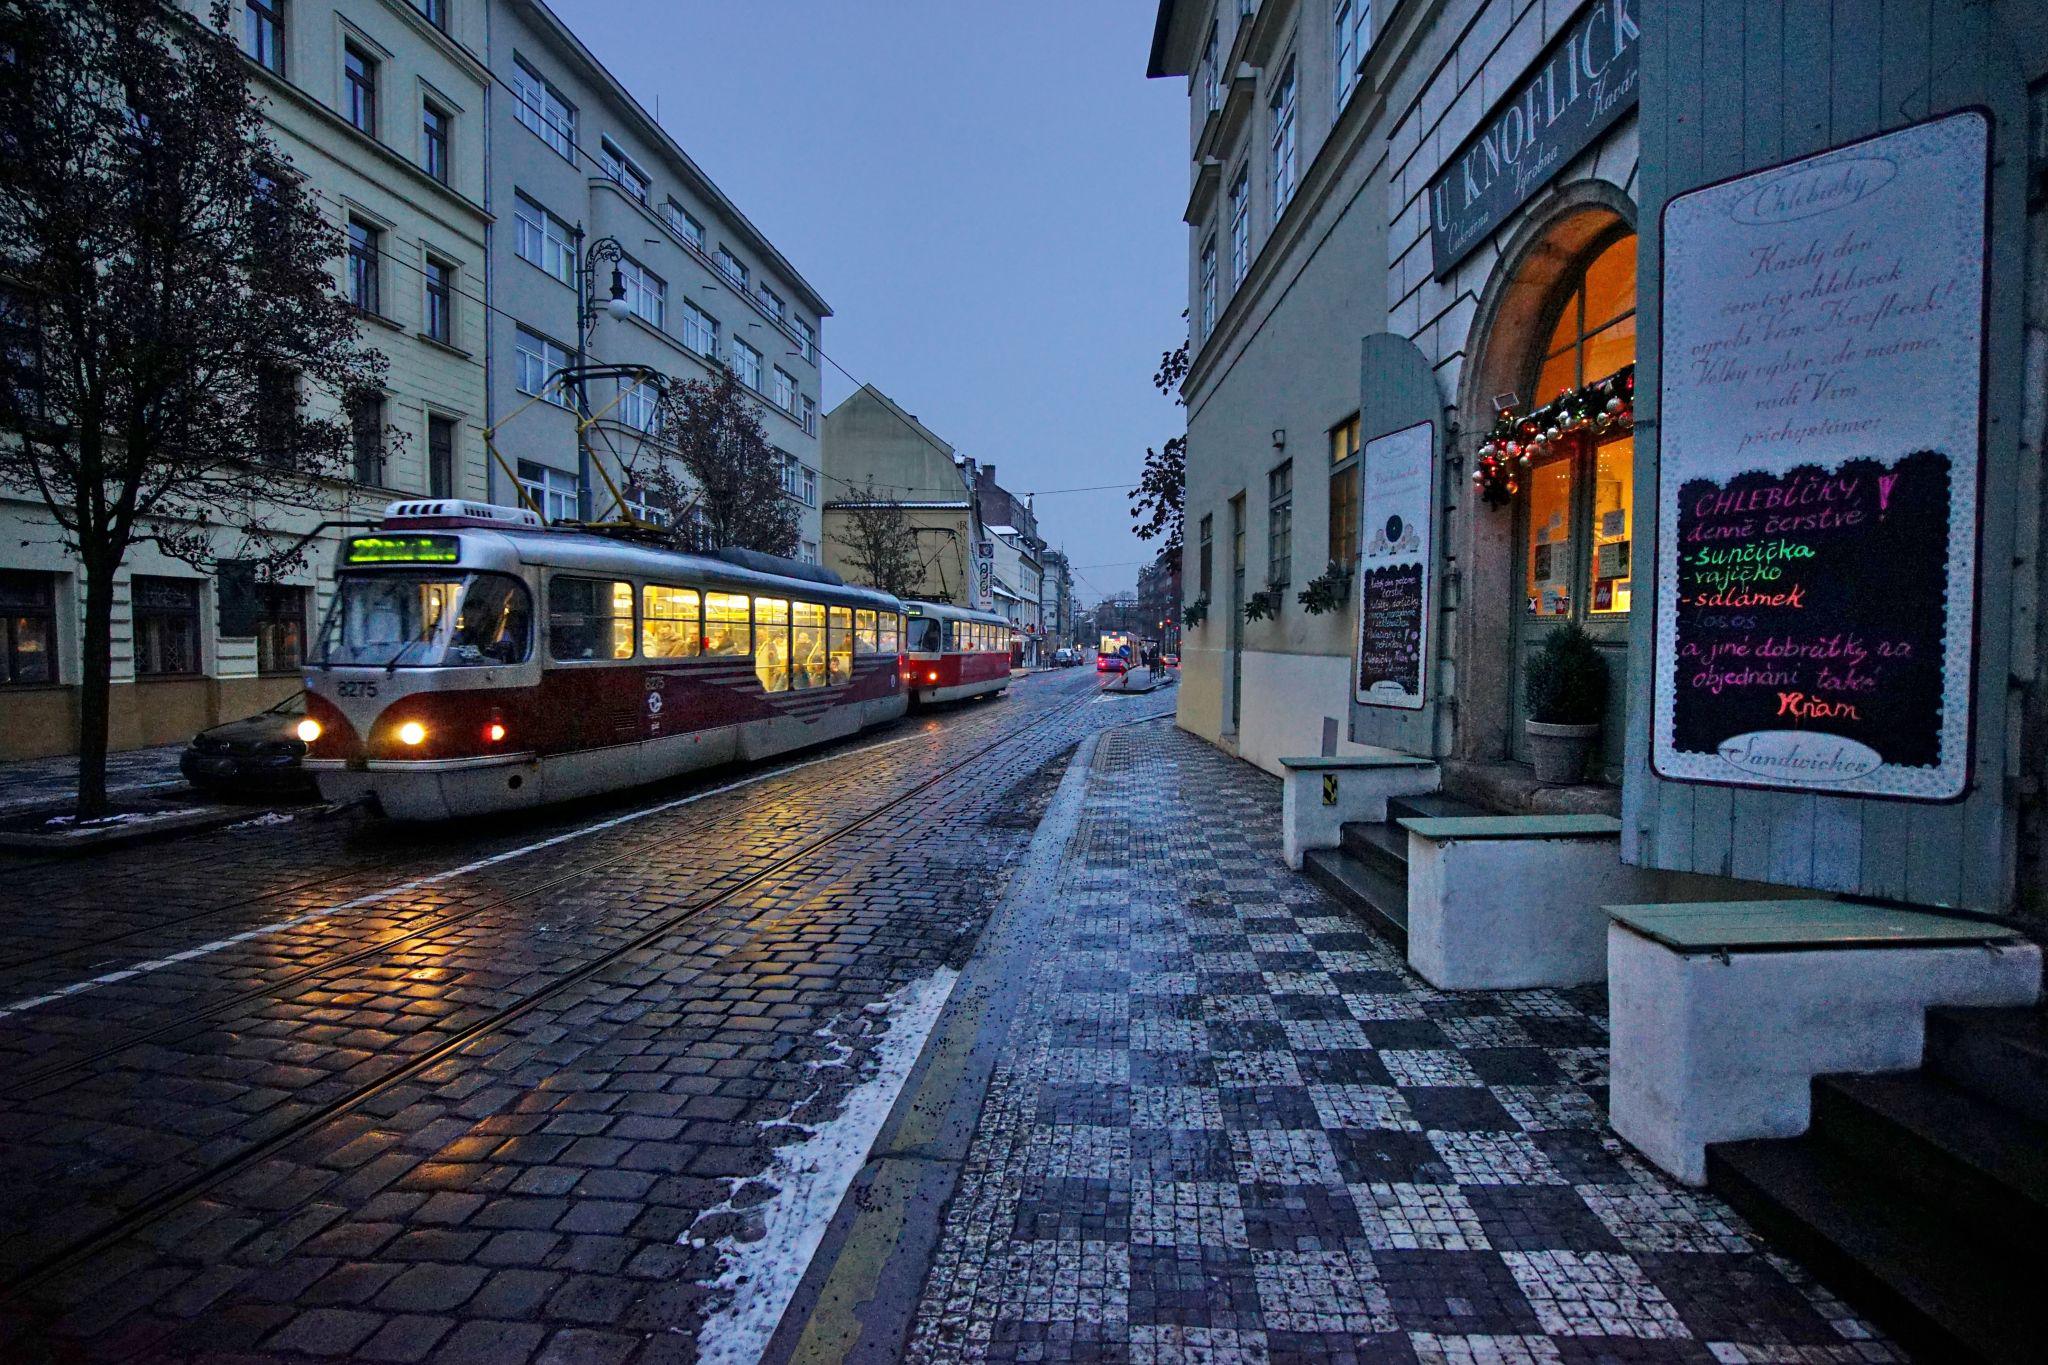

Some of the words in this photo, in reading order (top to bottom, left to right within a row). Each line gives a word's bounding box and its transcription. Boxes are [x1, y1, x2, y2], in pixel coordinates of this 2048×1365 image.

[1435, 178, 1456, 232] U
[1682, 642, 1701, 658] a
[1877, 640, 1914, 658] na
